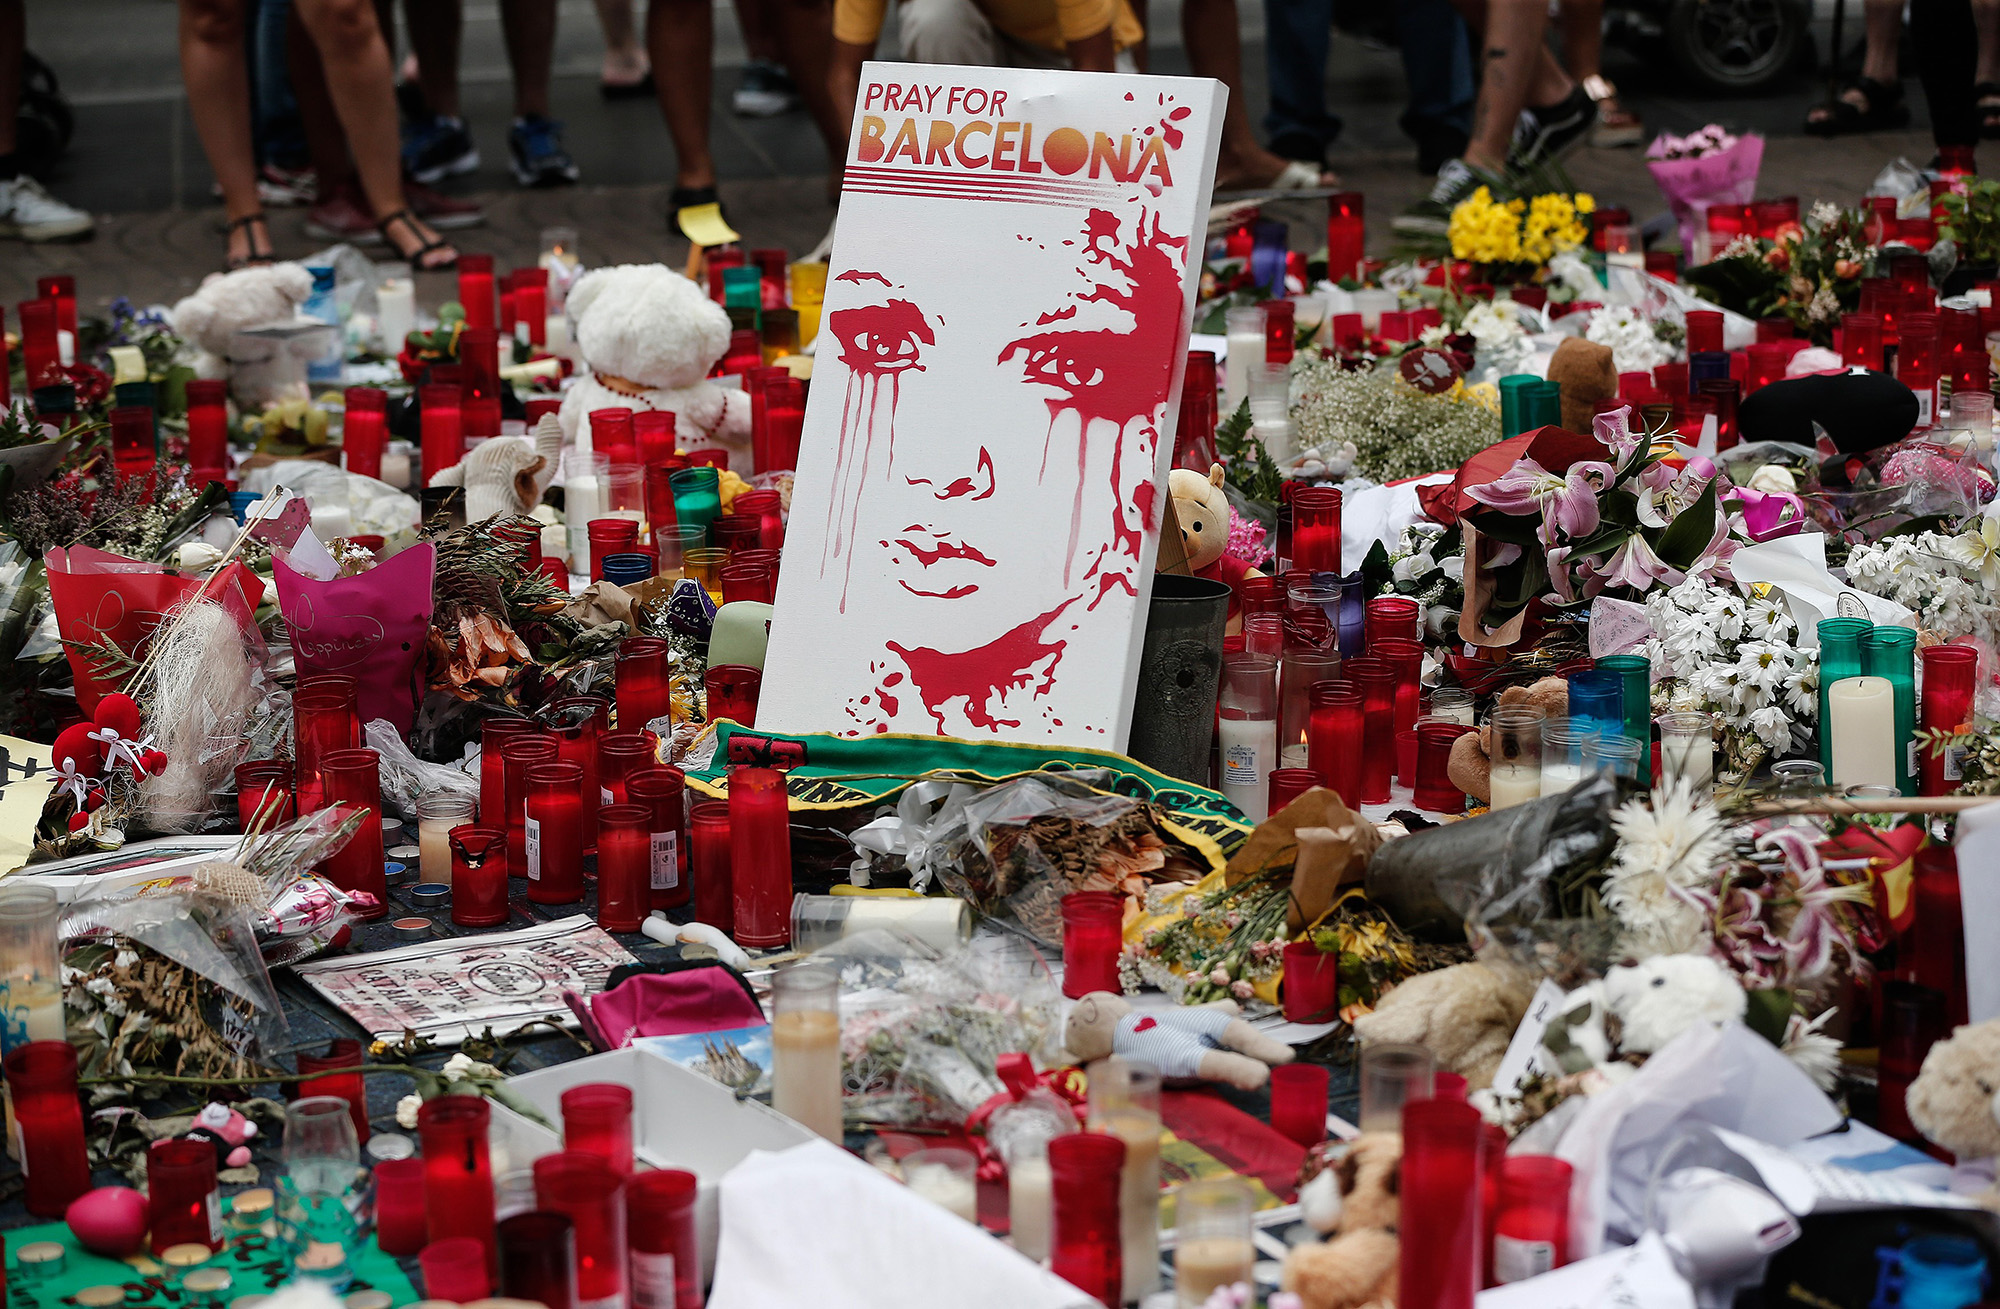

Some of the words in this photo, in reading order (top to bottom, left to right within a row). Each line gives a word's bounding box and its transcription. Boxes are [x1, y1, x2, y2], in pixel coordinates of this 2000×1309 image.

[864, 83, 942, 114] PRAY
[947, 87, 1008, 117] FOR
[857, 115, 1174, 188] BARCELONA
[281, 593, 384, 660] Happiness
[428, 971, 479, 1004] CAPITAL
